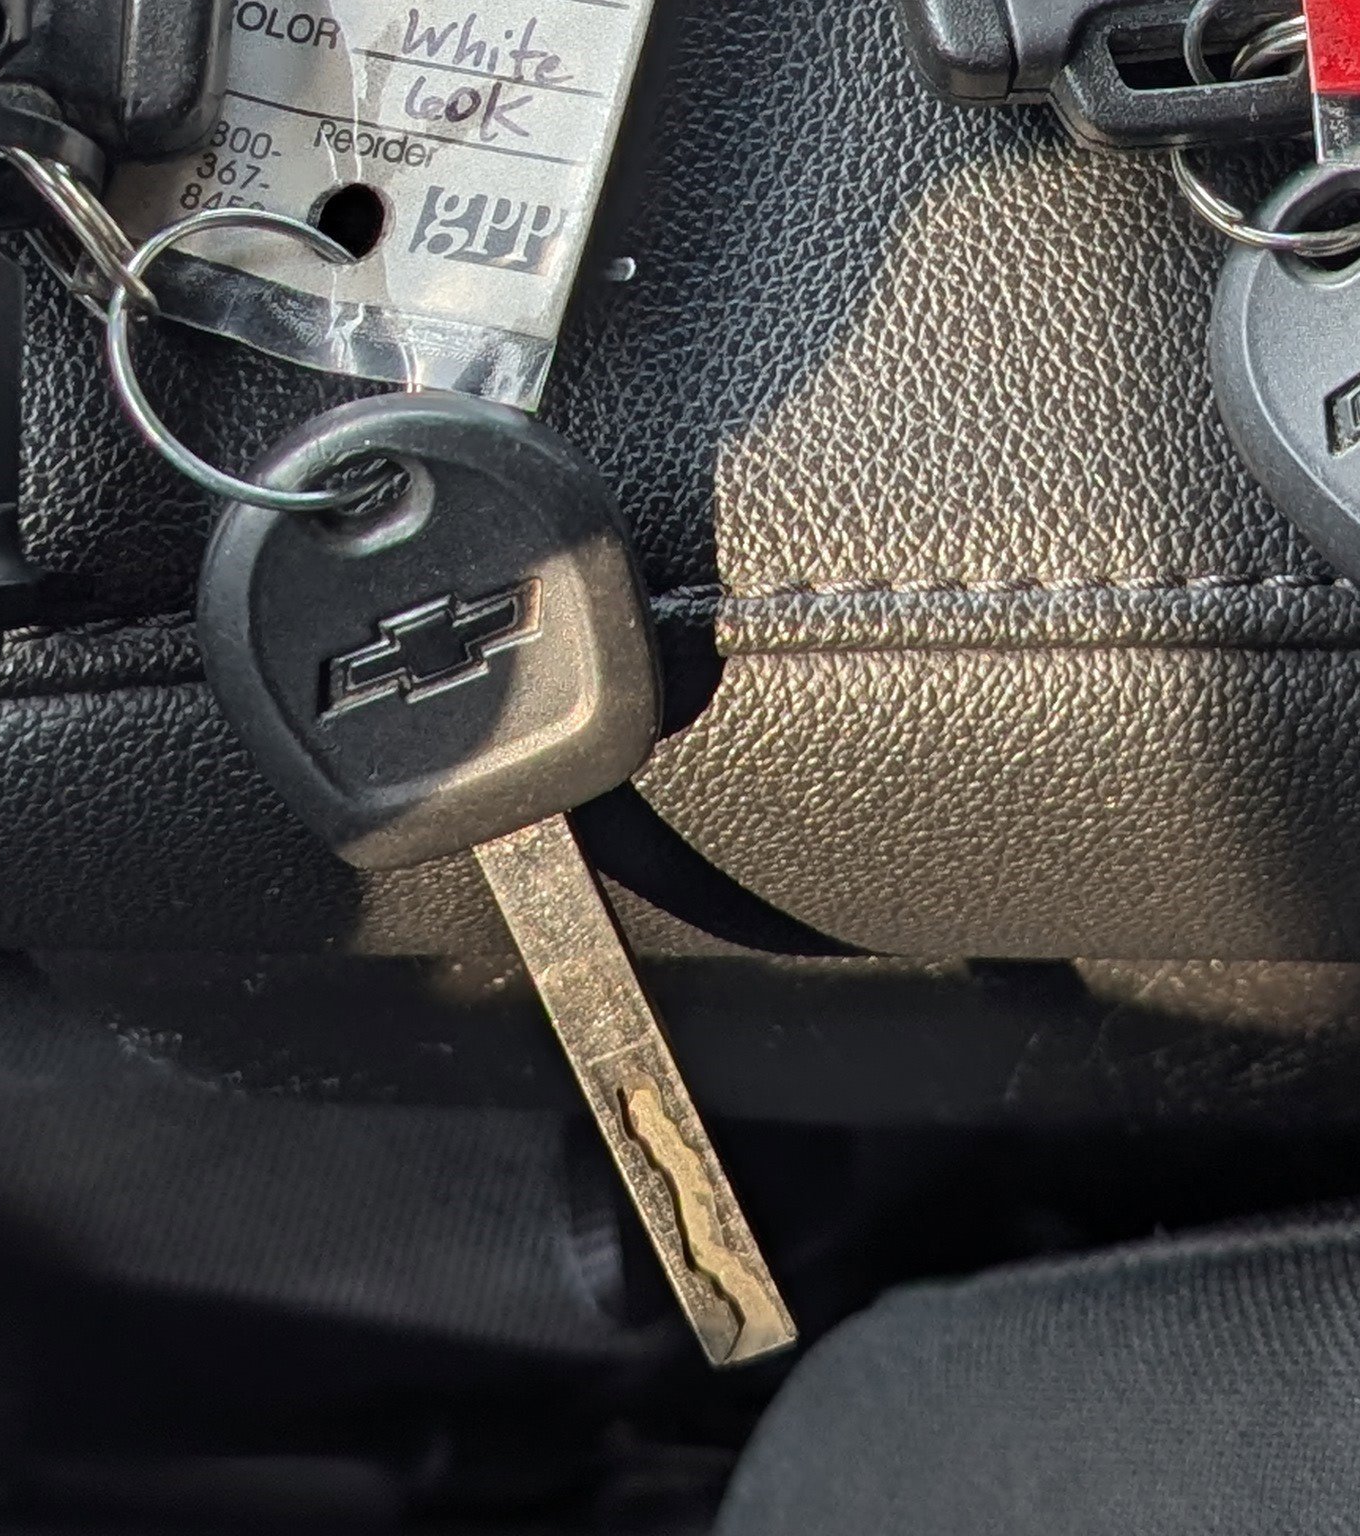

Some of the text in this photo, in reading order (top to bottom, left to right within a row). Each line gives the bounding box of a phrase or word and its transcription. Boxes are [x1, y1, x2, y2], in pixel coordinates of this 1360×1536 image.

[403, 7, 576, 86] White
[313, 118, 439, 169] Reorder
[196, 152, 271, 190] 367-
